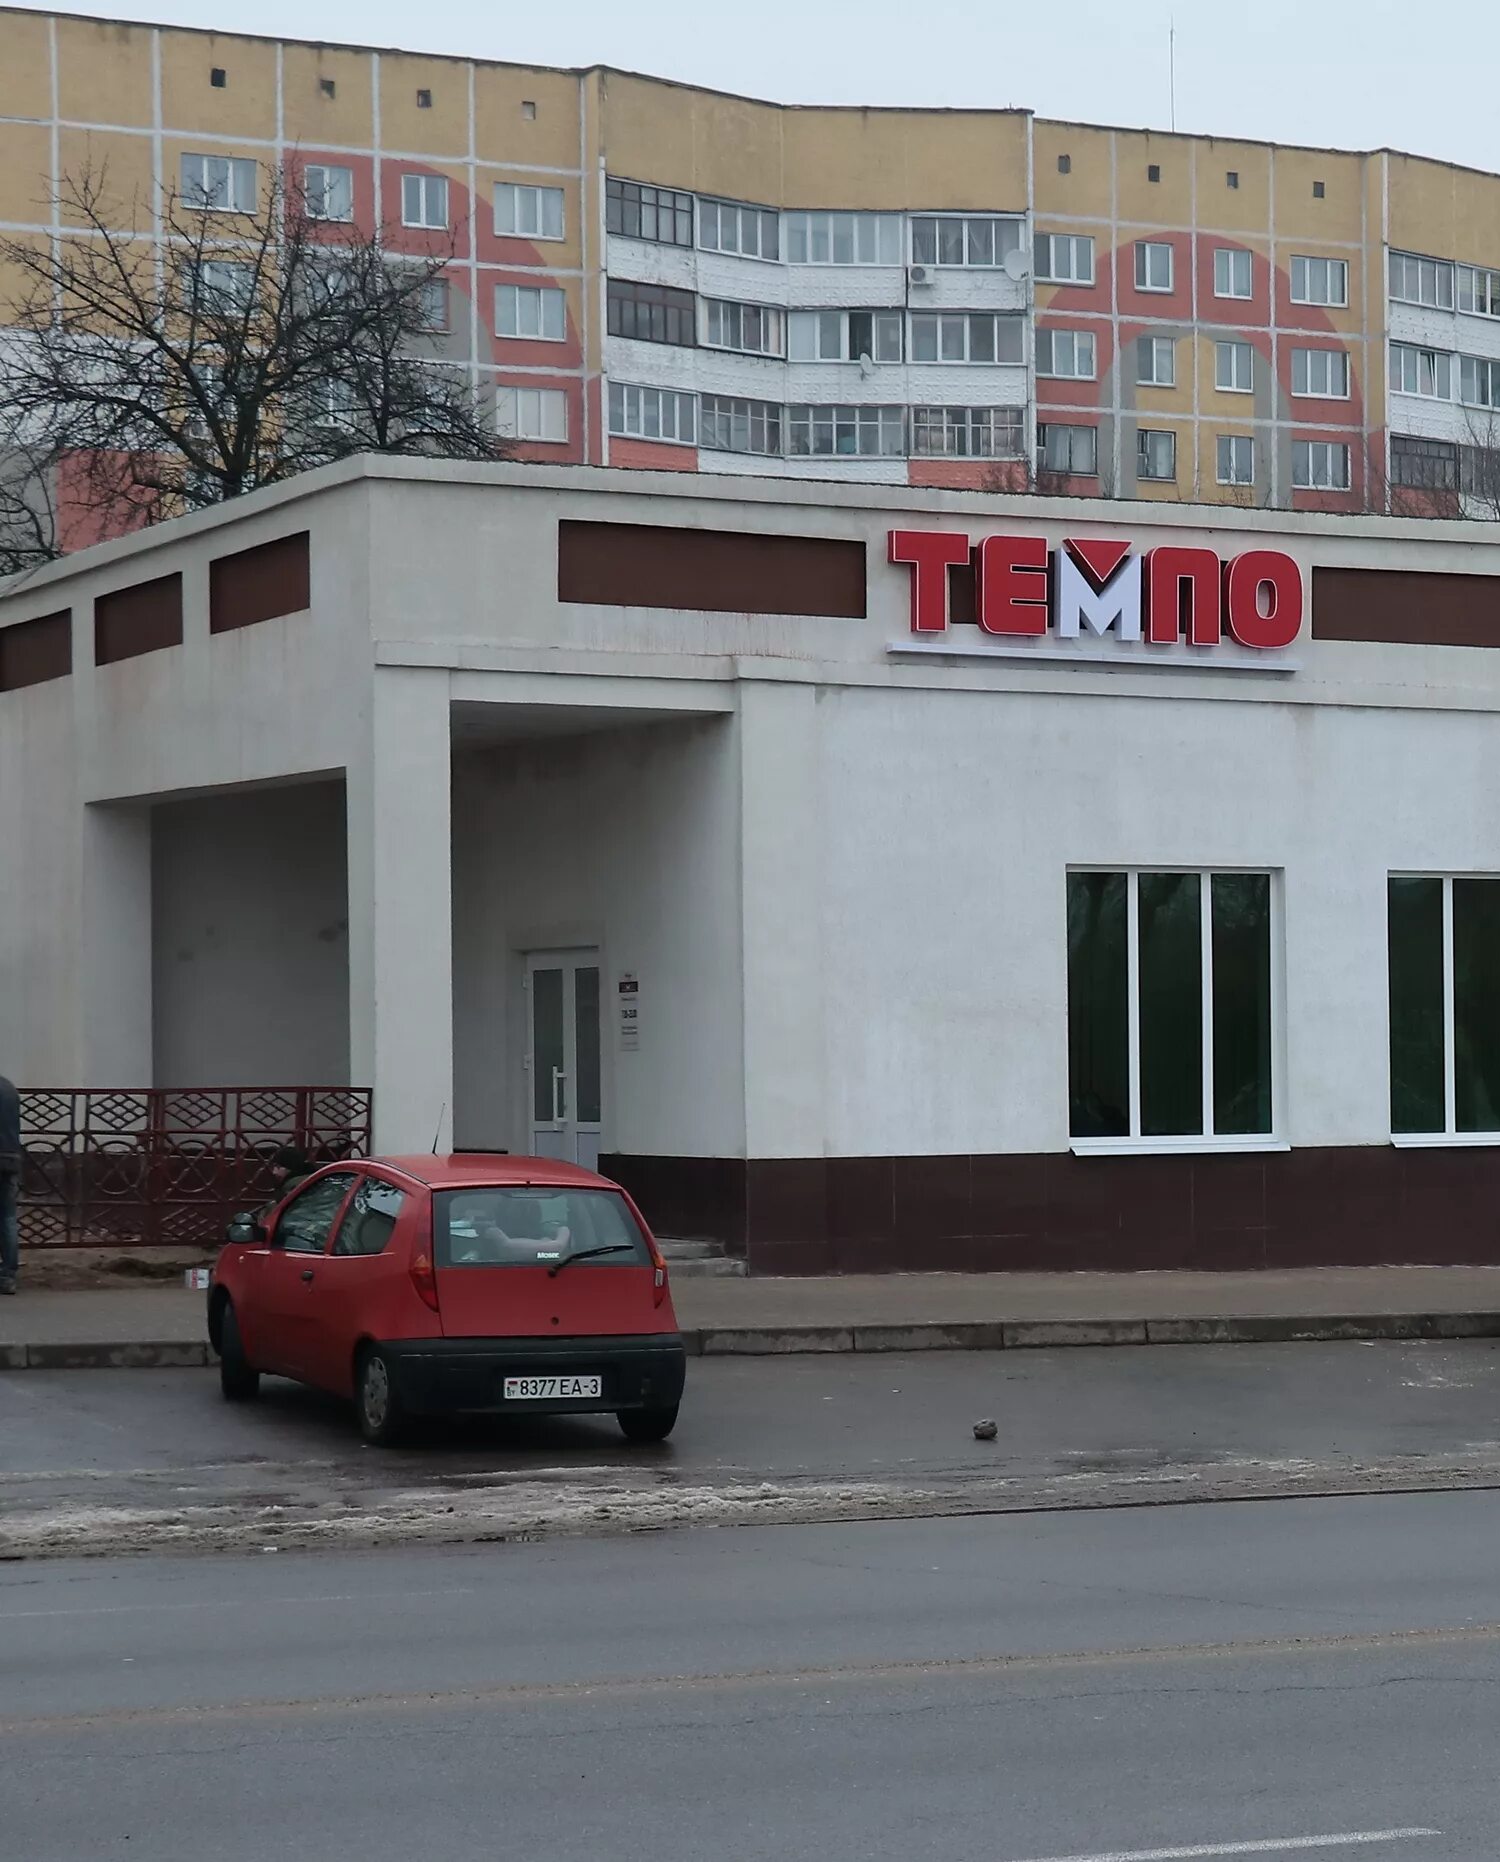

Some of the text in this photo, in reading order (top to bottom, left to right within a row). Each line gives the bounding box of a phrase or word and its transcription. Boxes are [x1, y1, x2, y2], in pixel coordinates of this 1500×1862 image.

[887, 529, 1303, 649] ТЕМПО
[520, 1379, 598, 1396] 8377 EA-3
